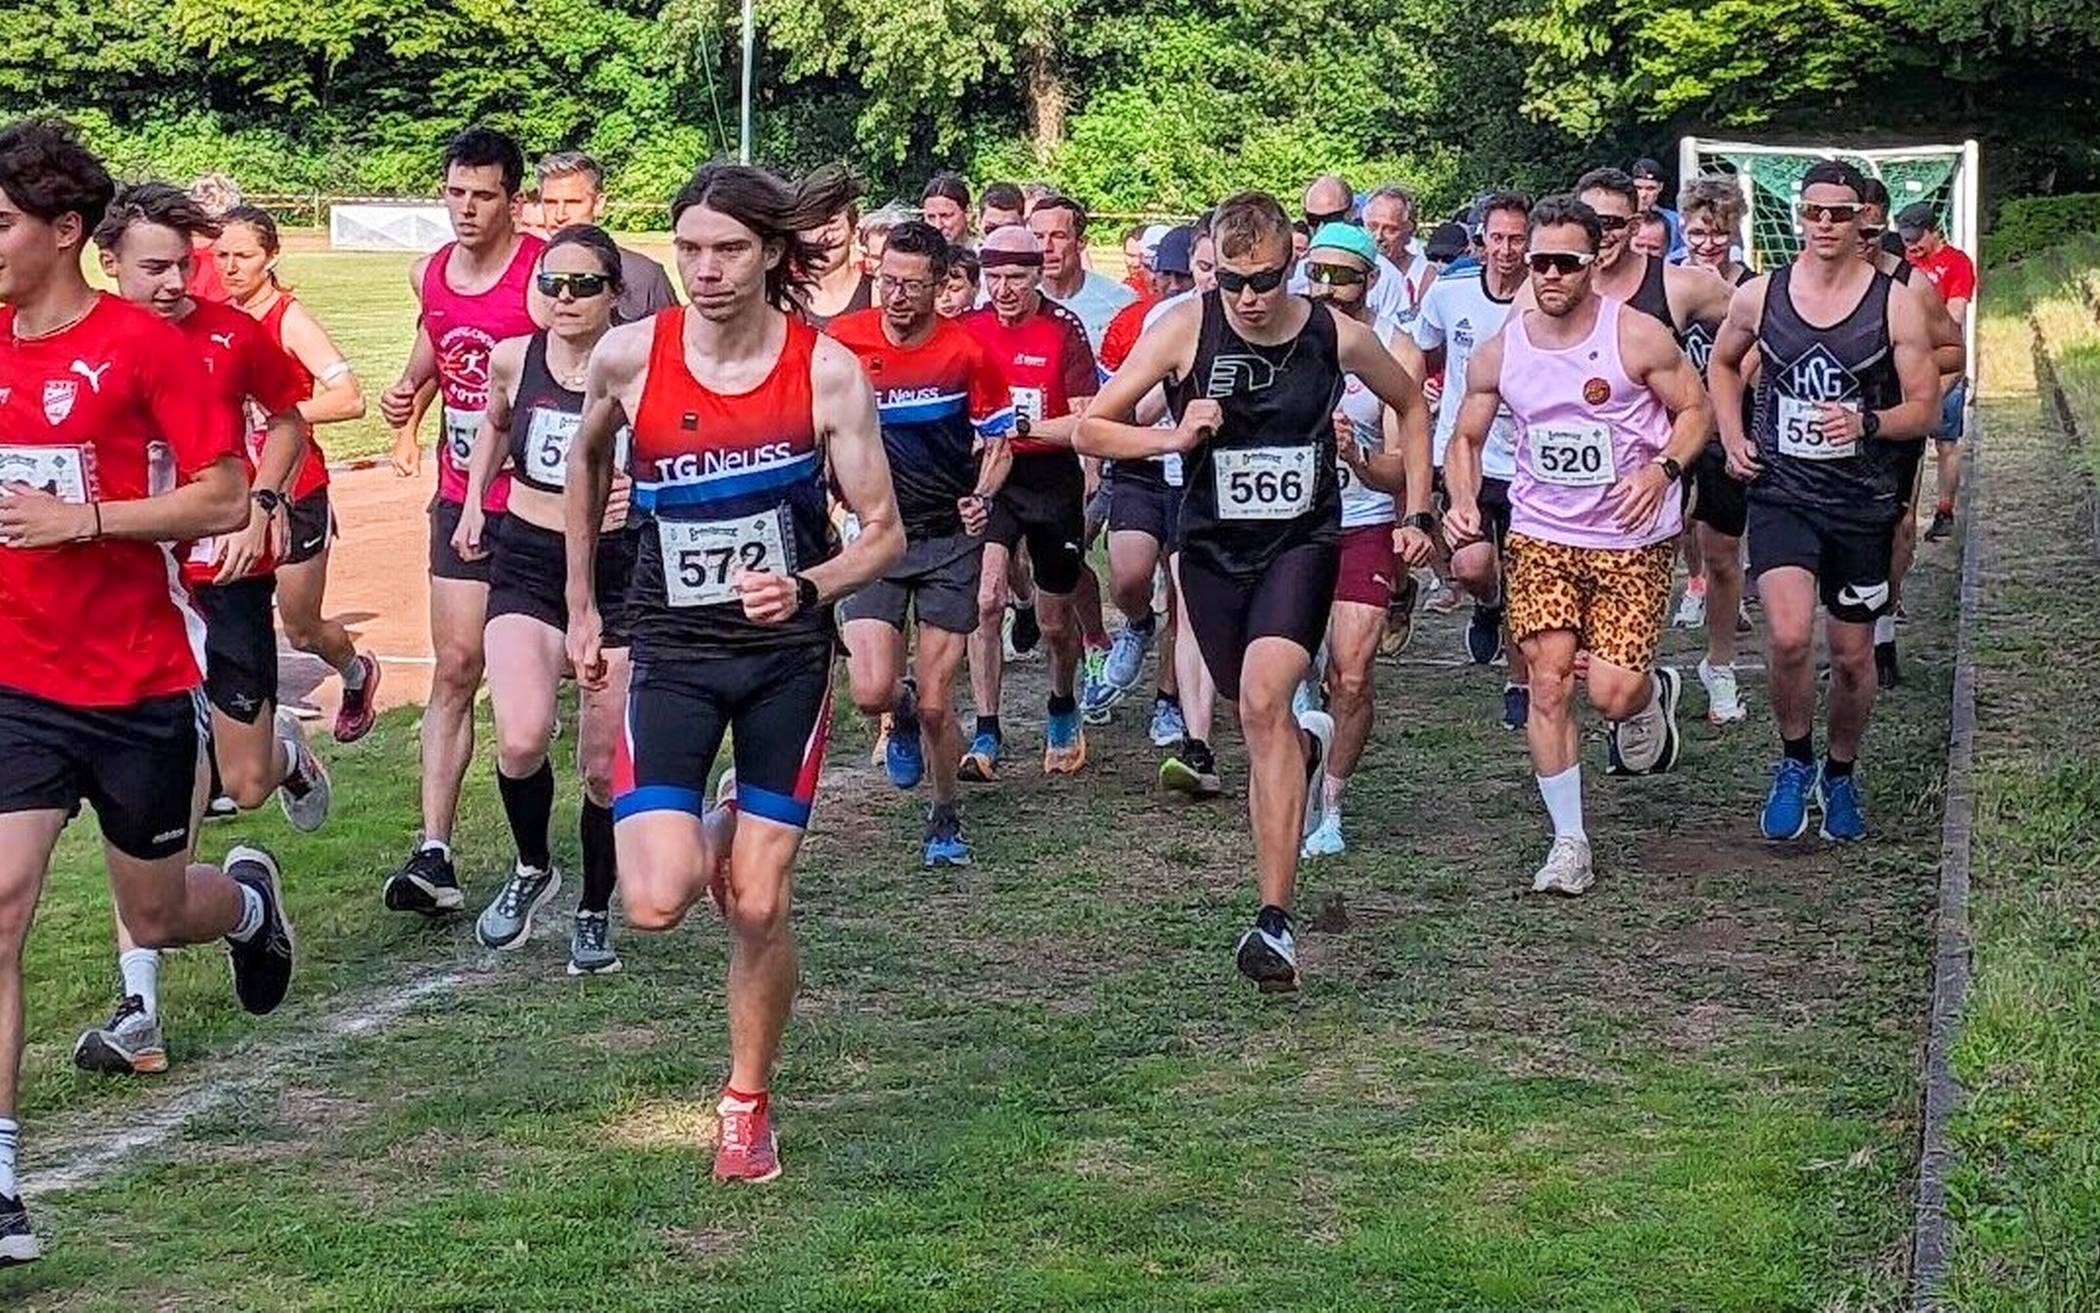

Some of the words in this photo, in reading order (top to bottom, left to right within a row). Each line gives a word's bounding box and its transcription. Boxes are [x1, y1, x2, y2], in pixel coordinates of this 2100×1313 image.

[1793, 357, 1841, 402] HSG
[1787, 418, 1836, 446] 55
[655, 453, 697, 483] TG
[703, 442, 791, 477] Neuss
[1541, 446, 1601, 472] 520
[1231, 471, 1302, 503] 566
[680, 541, 770, 588] 572
